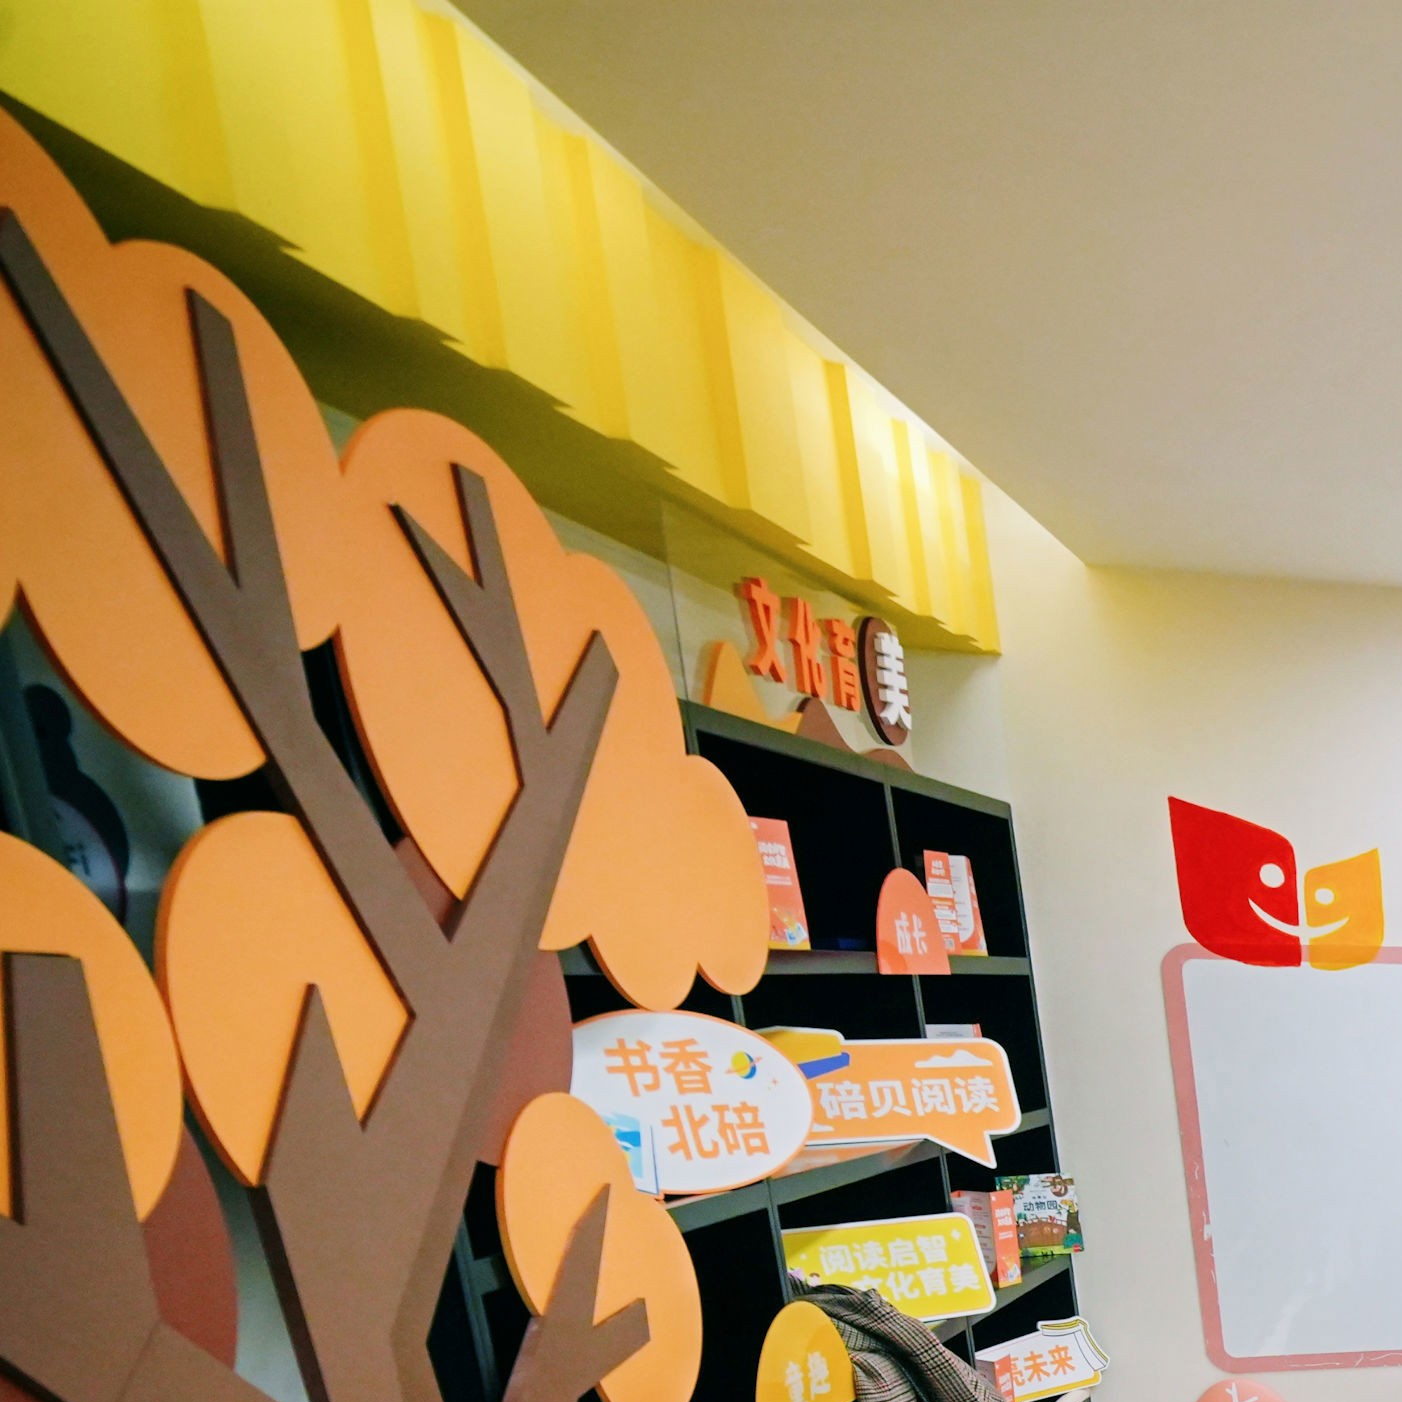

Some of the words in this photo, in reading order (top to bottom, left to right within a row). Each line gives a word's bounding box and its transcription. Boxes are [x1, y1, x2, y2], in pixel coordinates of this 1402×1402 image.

[741, 576, 912, 730] 文化育美
[895, 911, 928, 955] 成长
[604, 1038, 713, 1097] 书香
[816, 1077, 1000, 1121] 碚贝阅读
[662, 1101, 770, 1162] 北碚
[1023, 1200, 1058, 1212] 动物园
[819, 1235, 948, 1277] 阅读启智
